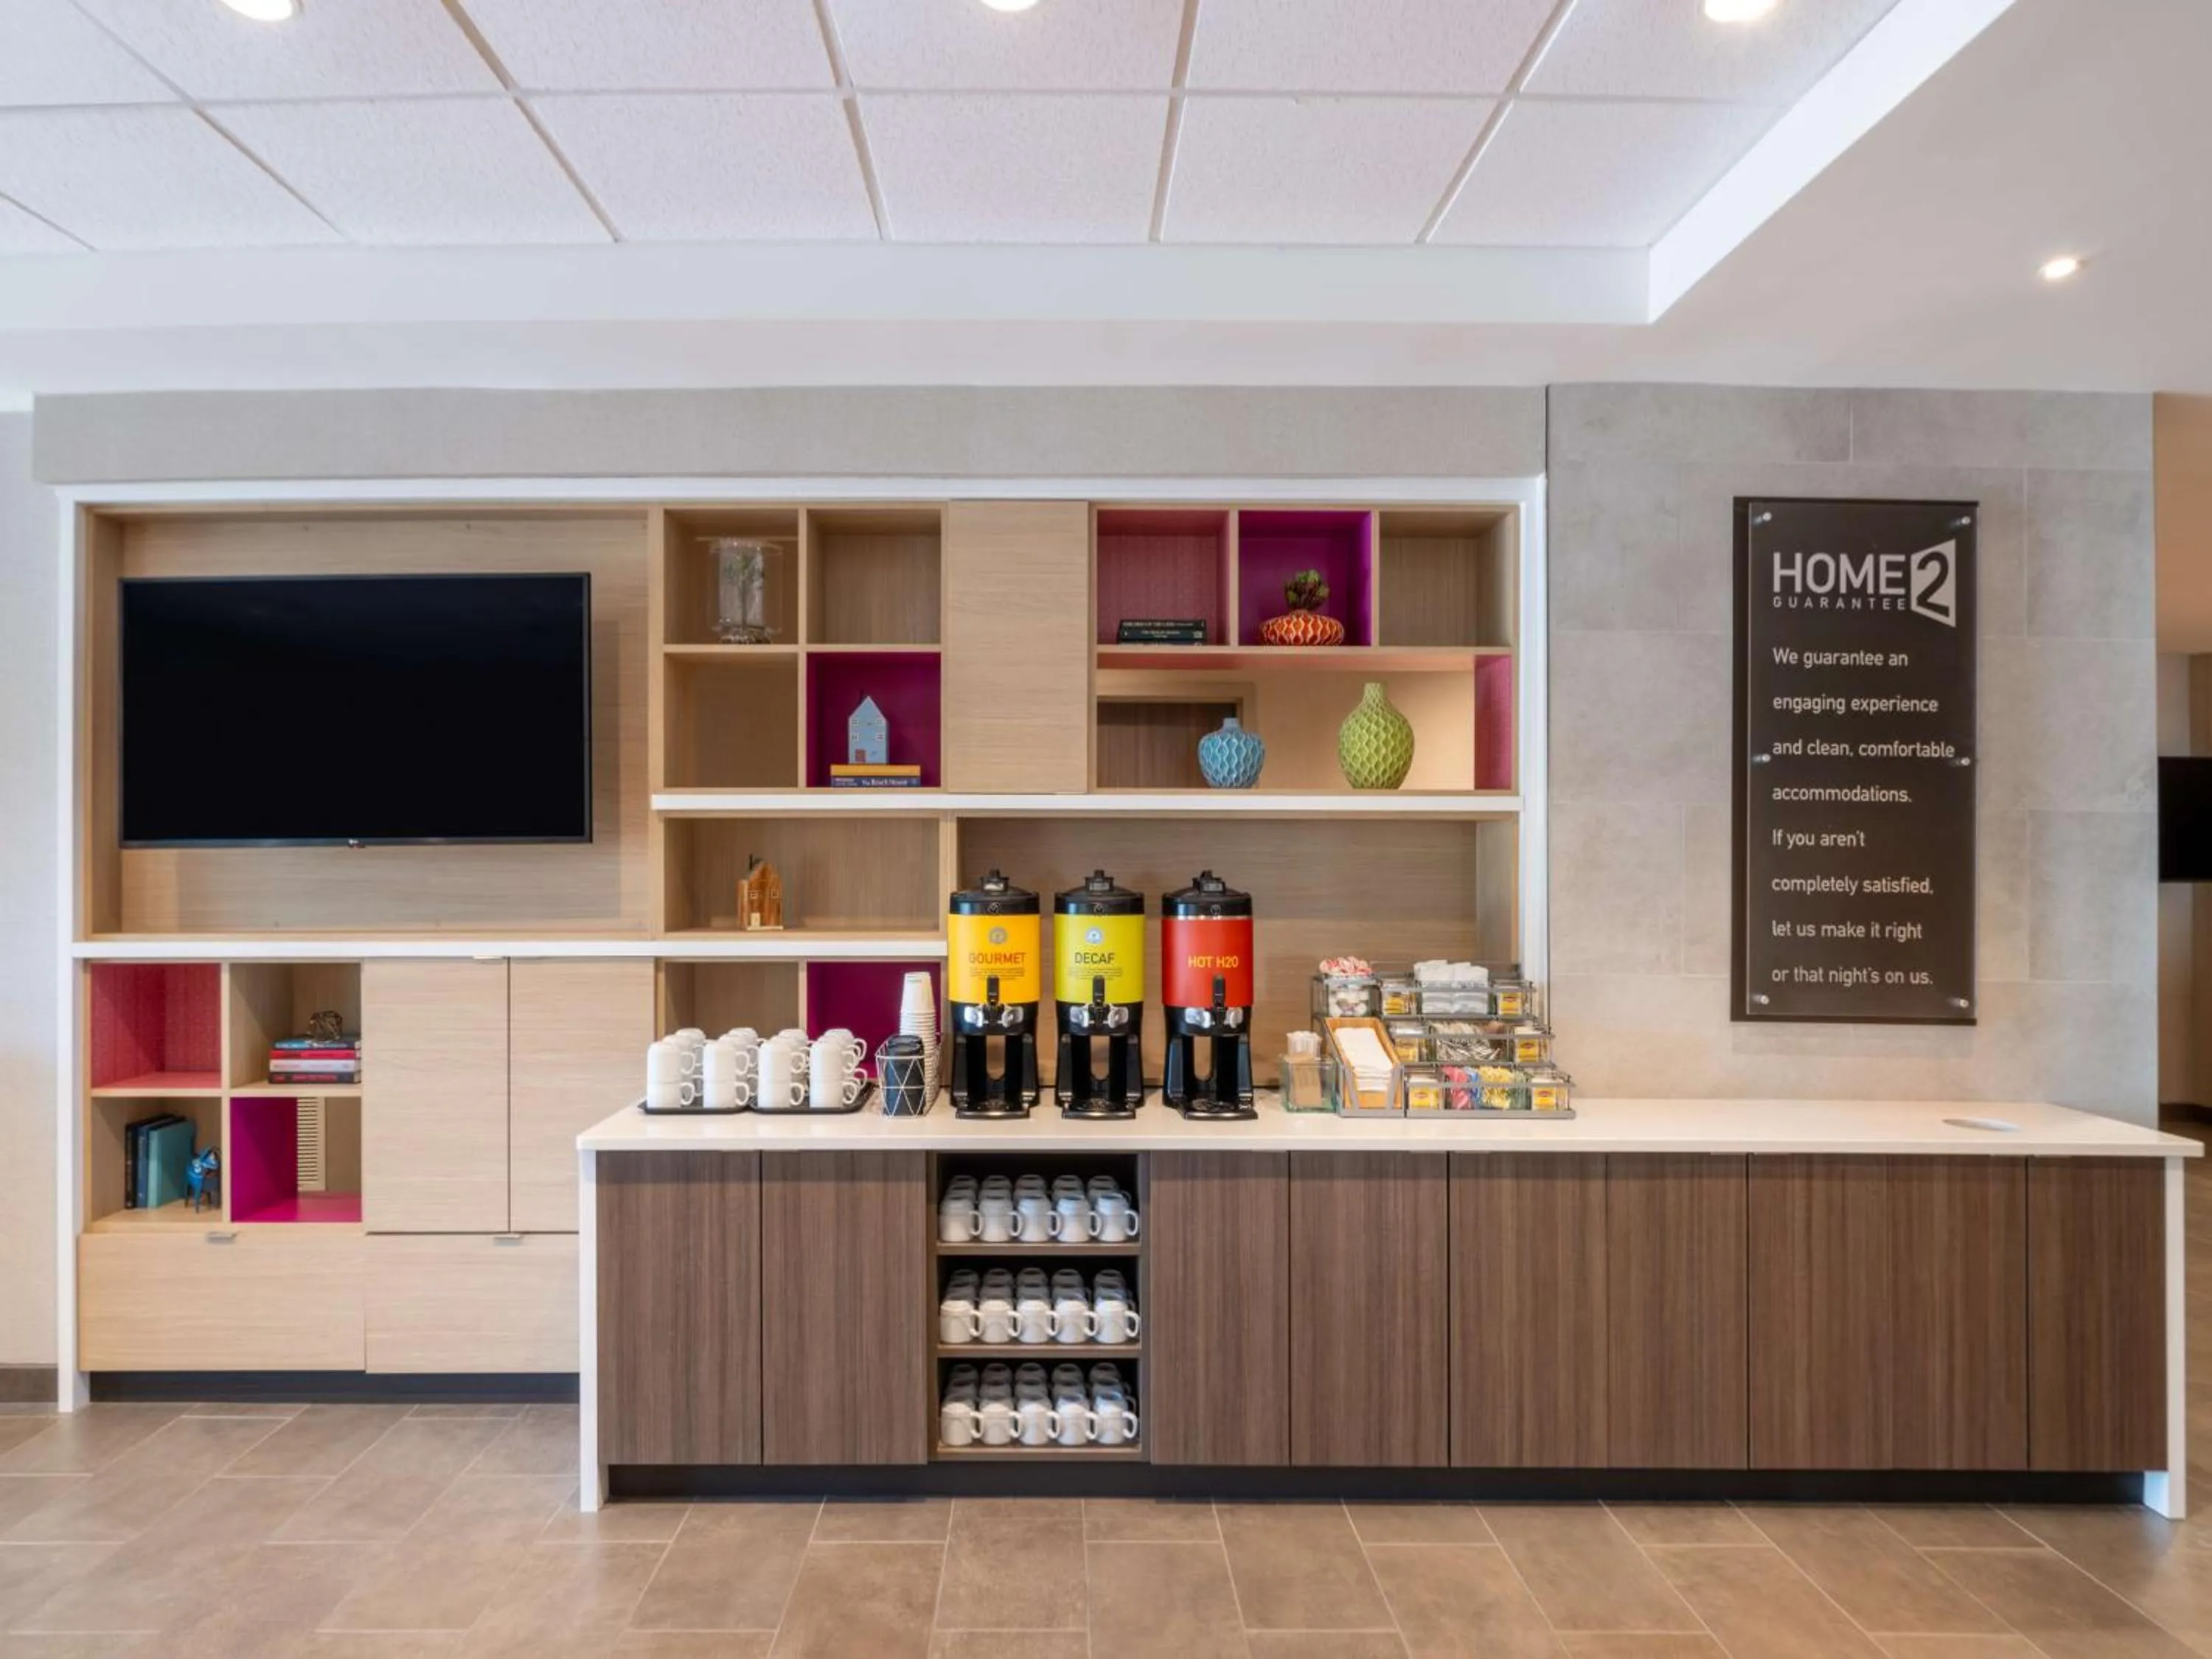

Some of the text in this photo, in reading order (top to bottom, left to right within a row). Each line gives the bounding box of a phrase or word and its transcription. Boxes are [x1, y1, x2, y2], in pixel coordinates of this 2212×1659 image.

[1773, 597, 1906, 611] GUARANTEE
[1773, 647, 1908, 669] We guarantee an
[1773, 693, 1938, 714] engaging experience
[1773, 738, 1803, 755] and
[1859, 740, 1955, 758] comfortable
[1772, 785, 1912, 802] accommodations.
[1773, 829, 1865, 849] If you aren't
[1772, 875, 1858, 896] completely
[1772, 920, 1922, 942] let us make it right
[968, 952, 1026, 964] GOURMET
[1074, 952, 1115, 964] DECAF
[1188, 956, 1214, 968] HOT
[1772, 967, 1933, 987] or that night's on us.
